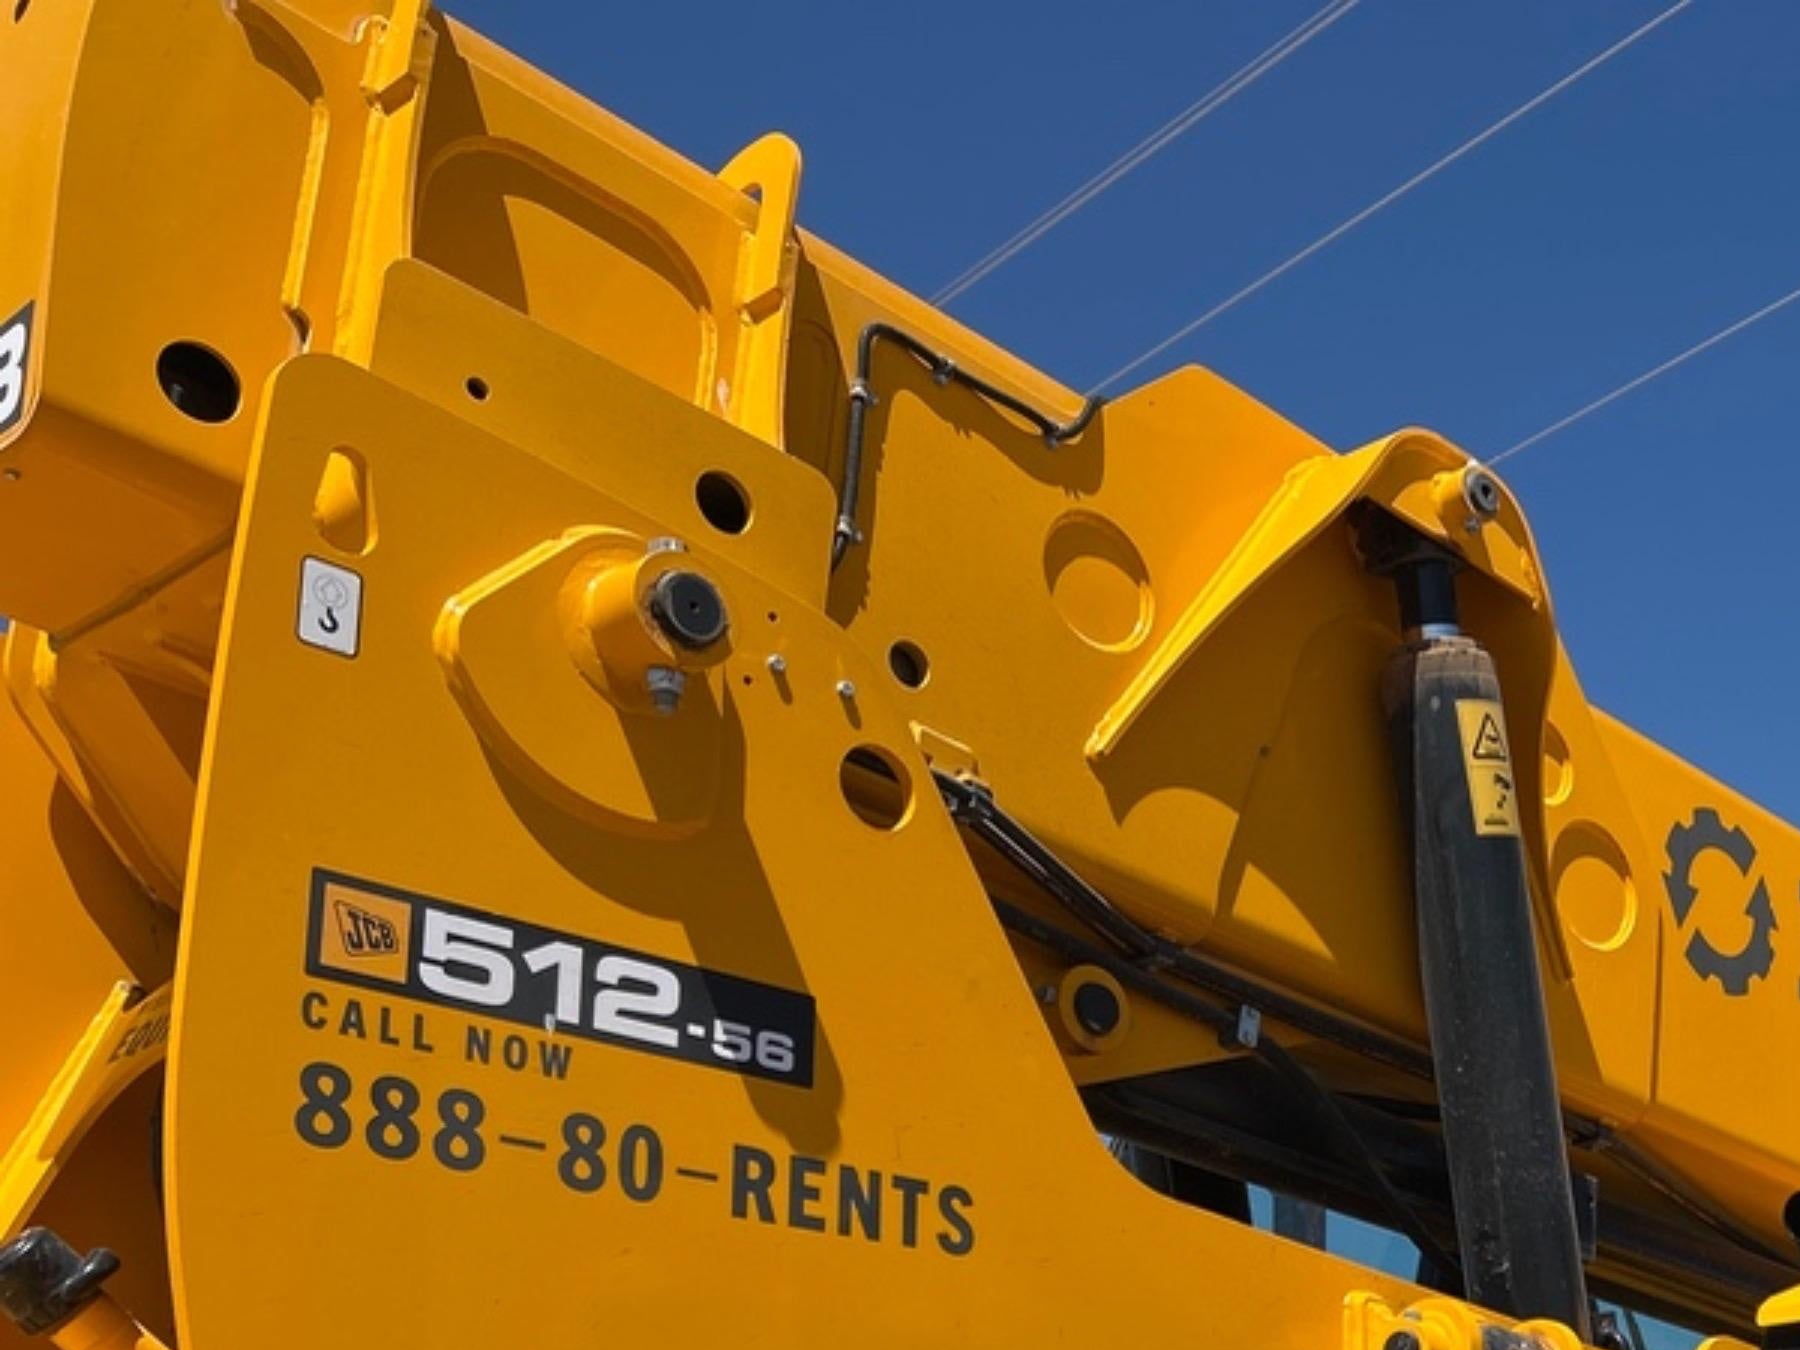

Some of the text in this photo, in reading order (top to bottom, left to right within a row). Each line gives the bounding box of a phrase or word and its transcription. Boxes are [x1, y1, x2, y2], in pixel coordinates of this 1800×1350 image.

[346, 910, 395, 950] JCB
[302, 992, 573, 1080] CALL NOW
[294, 1061, 977, 1256] 888-80-RENTS
